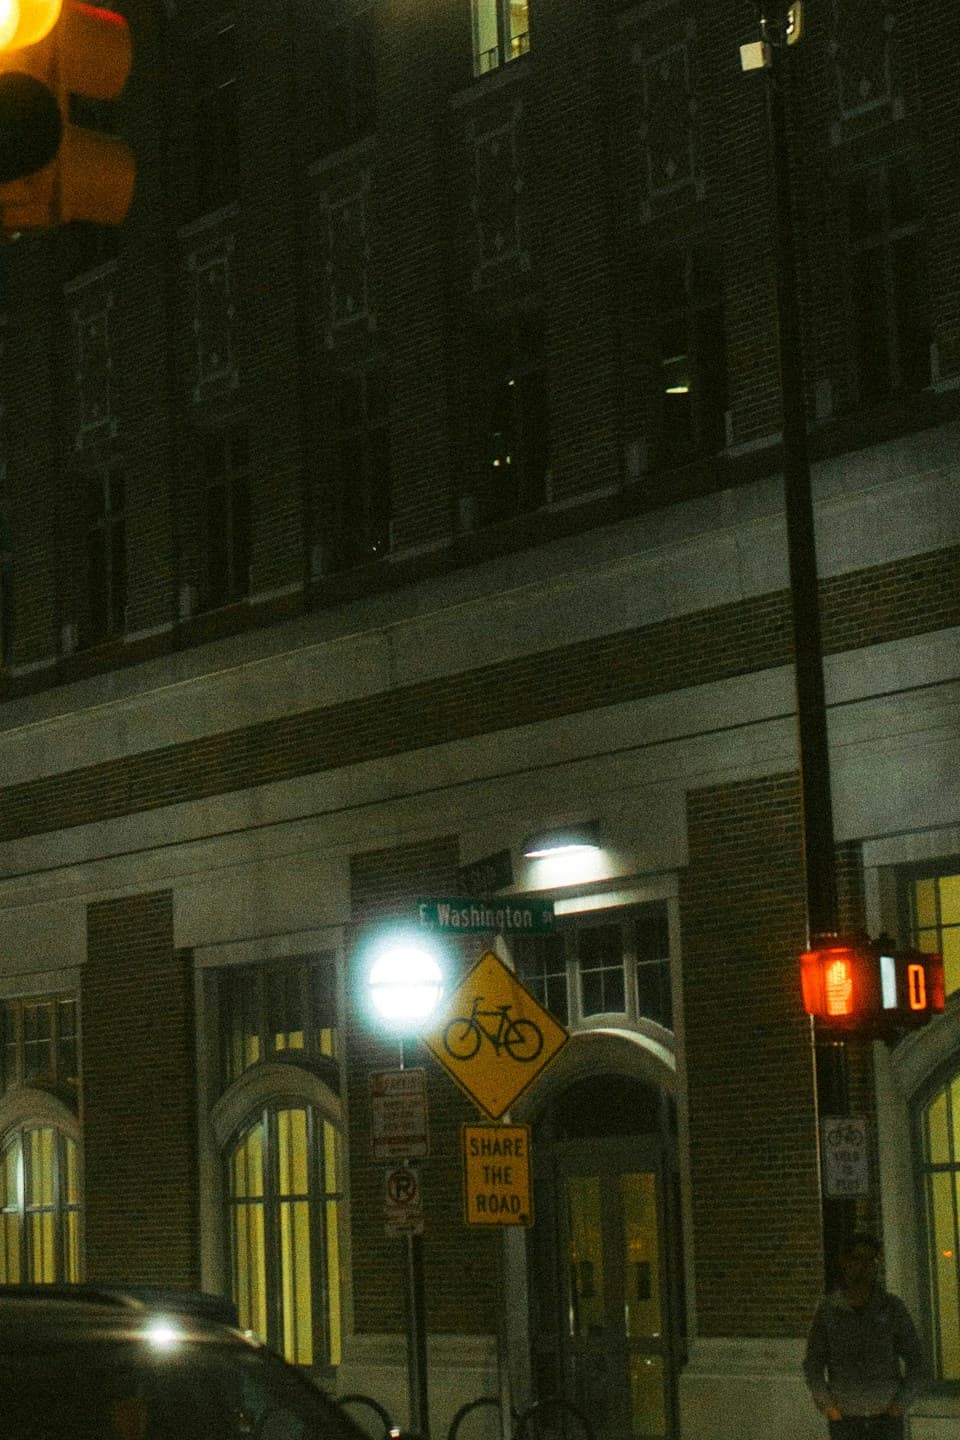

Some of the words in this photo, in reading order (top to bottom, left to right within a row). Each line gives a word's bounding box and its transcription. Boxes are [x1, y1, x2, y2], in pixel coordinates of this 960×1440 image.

[437, 902, 533, 931] Washington
[470, 1137, 524, 1157] SHARE
[483, 1164, 512, 1185] THE
[476, 1193, 521, 1213] ROAD
